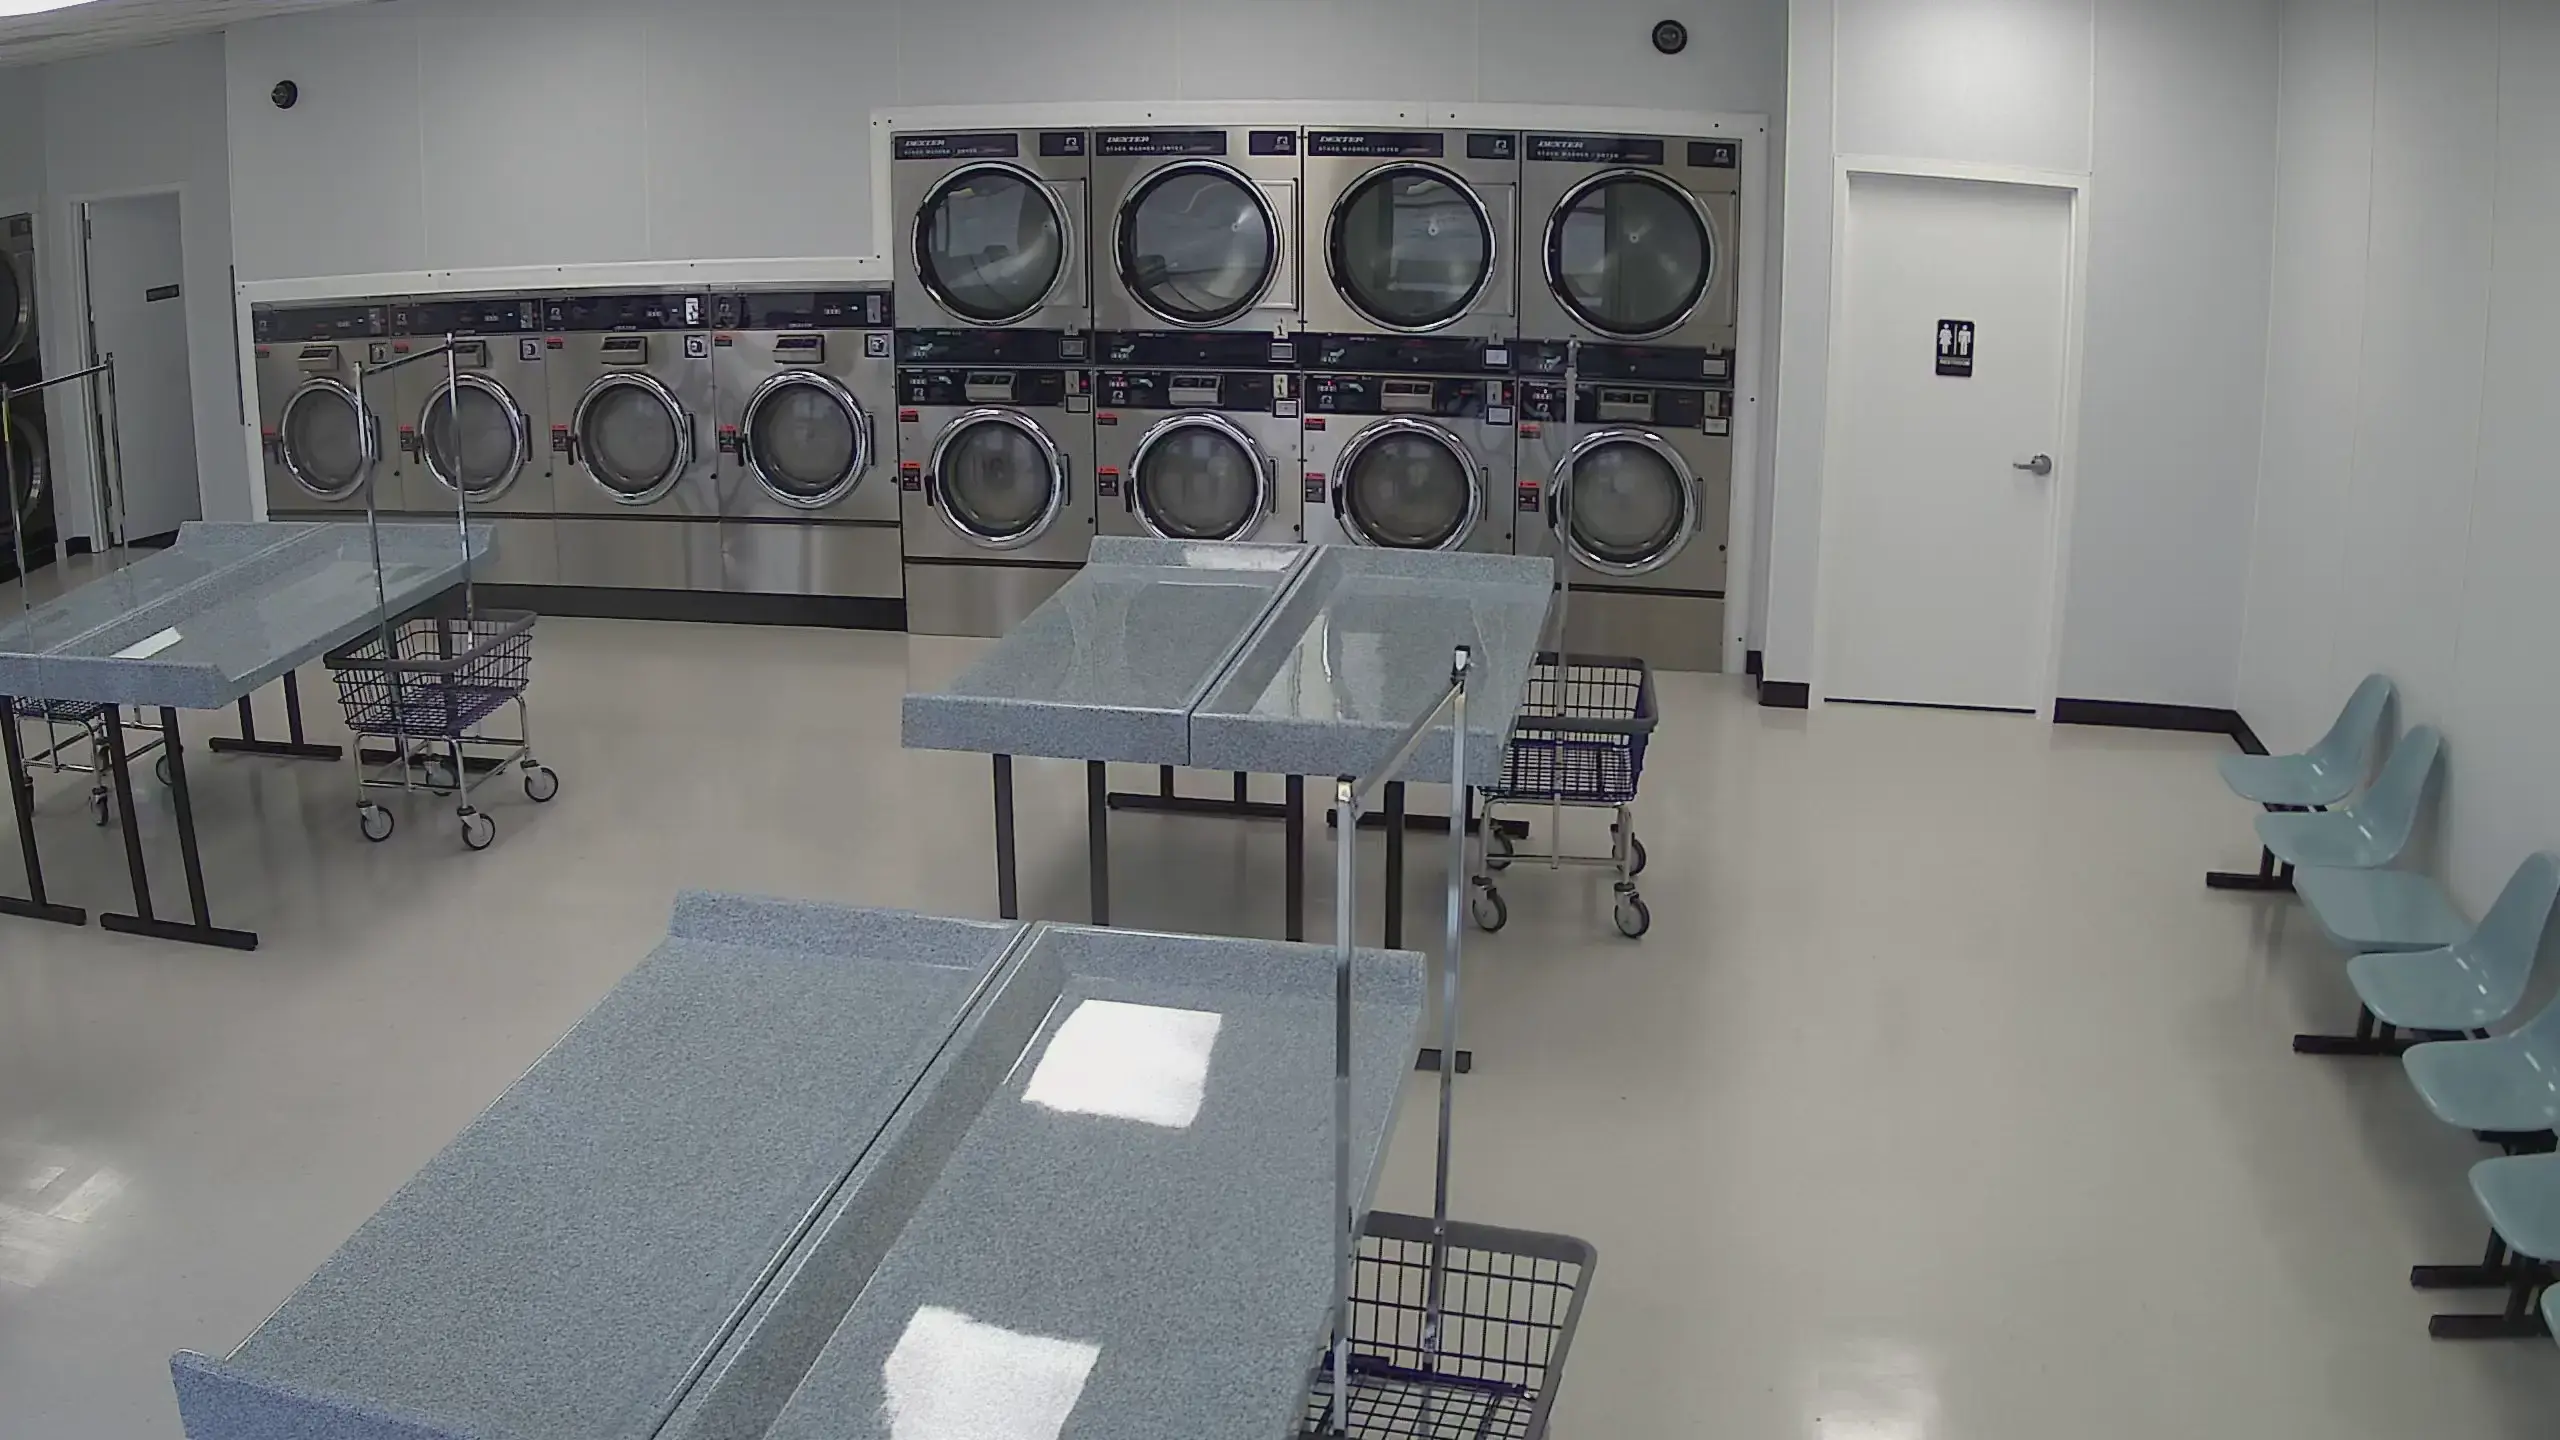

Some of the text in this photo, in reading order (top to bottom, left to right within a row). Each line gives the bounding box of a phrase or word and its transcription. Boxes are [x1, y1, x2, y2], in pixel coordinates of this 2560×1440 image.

[904, 139, 946, 147] DEXTER
[1107, 135, 1150, 143] DEXTER
[1319, 135, 1365, 143] DEXTER
[1537, 140, 1584, 149] DEXTER
